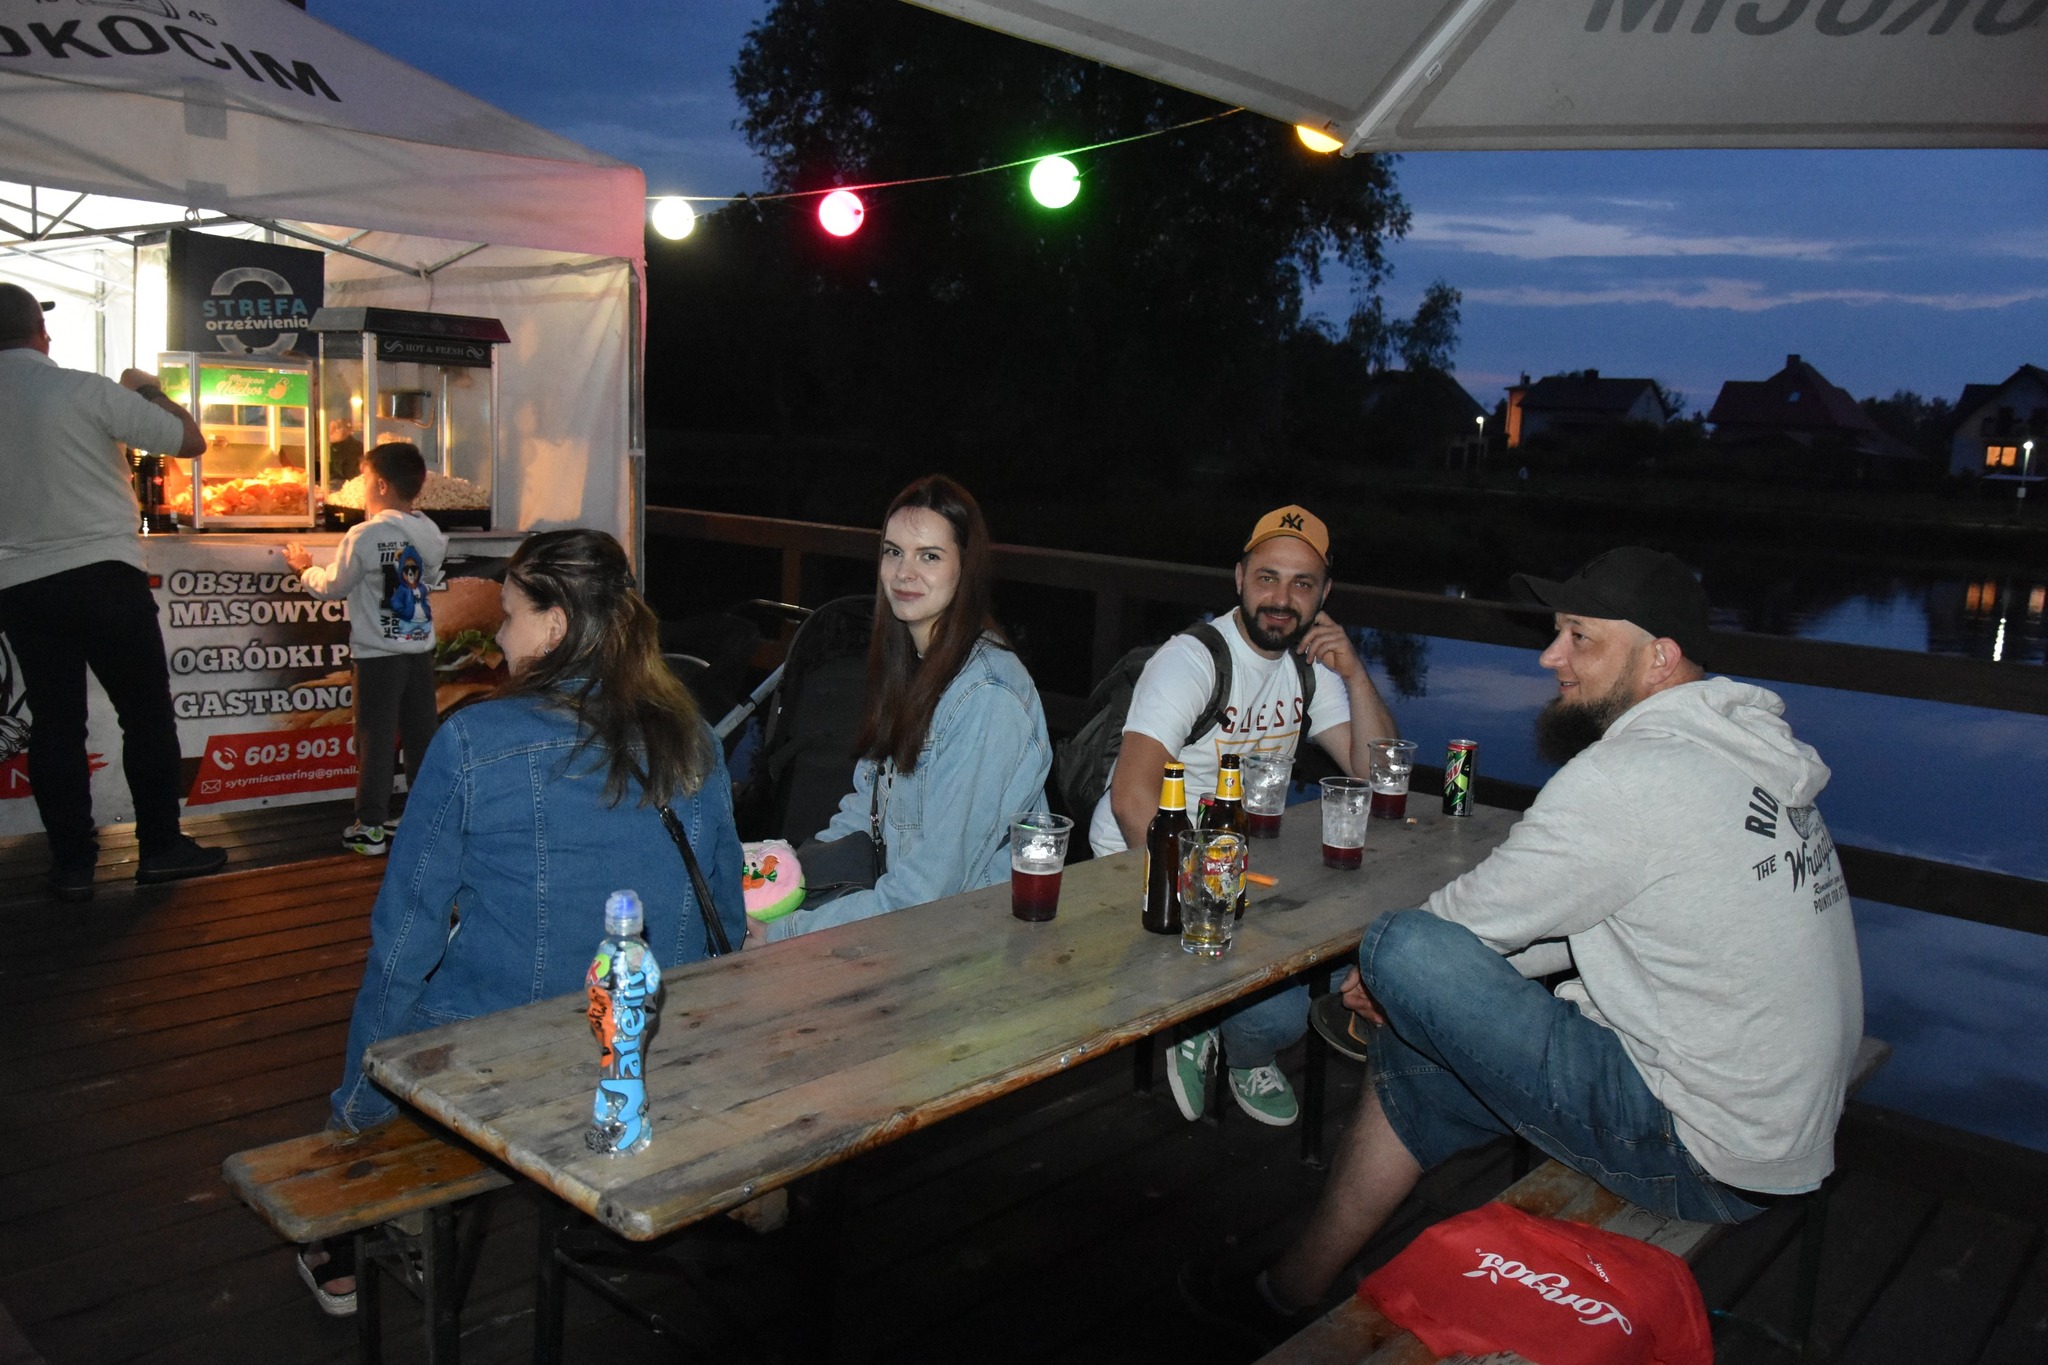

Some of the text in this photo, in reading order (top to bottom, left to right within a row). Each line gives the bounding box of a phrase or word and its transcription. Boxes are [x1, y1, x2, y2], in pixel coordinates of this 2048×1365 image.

[189, 9, 218, 26] 45
[202, 297, 308, 317] STREFA
[206, 315, 308, 331] orzeźwienia
[405, 344, 424, 353] HOT
[436, 346, 464, 356] FRESH
[1278, 512, 1304, 532] NY
[170, 571, 309, 596] OBSŁUG
[172, 640, 325, 674] OGRÓDKI
[245, 743, 290, 767] 603
[296, 737, 340, 759] 903
[1752, 854, 1778, 881] THE
